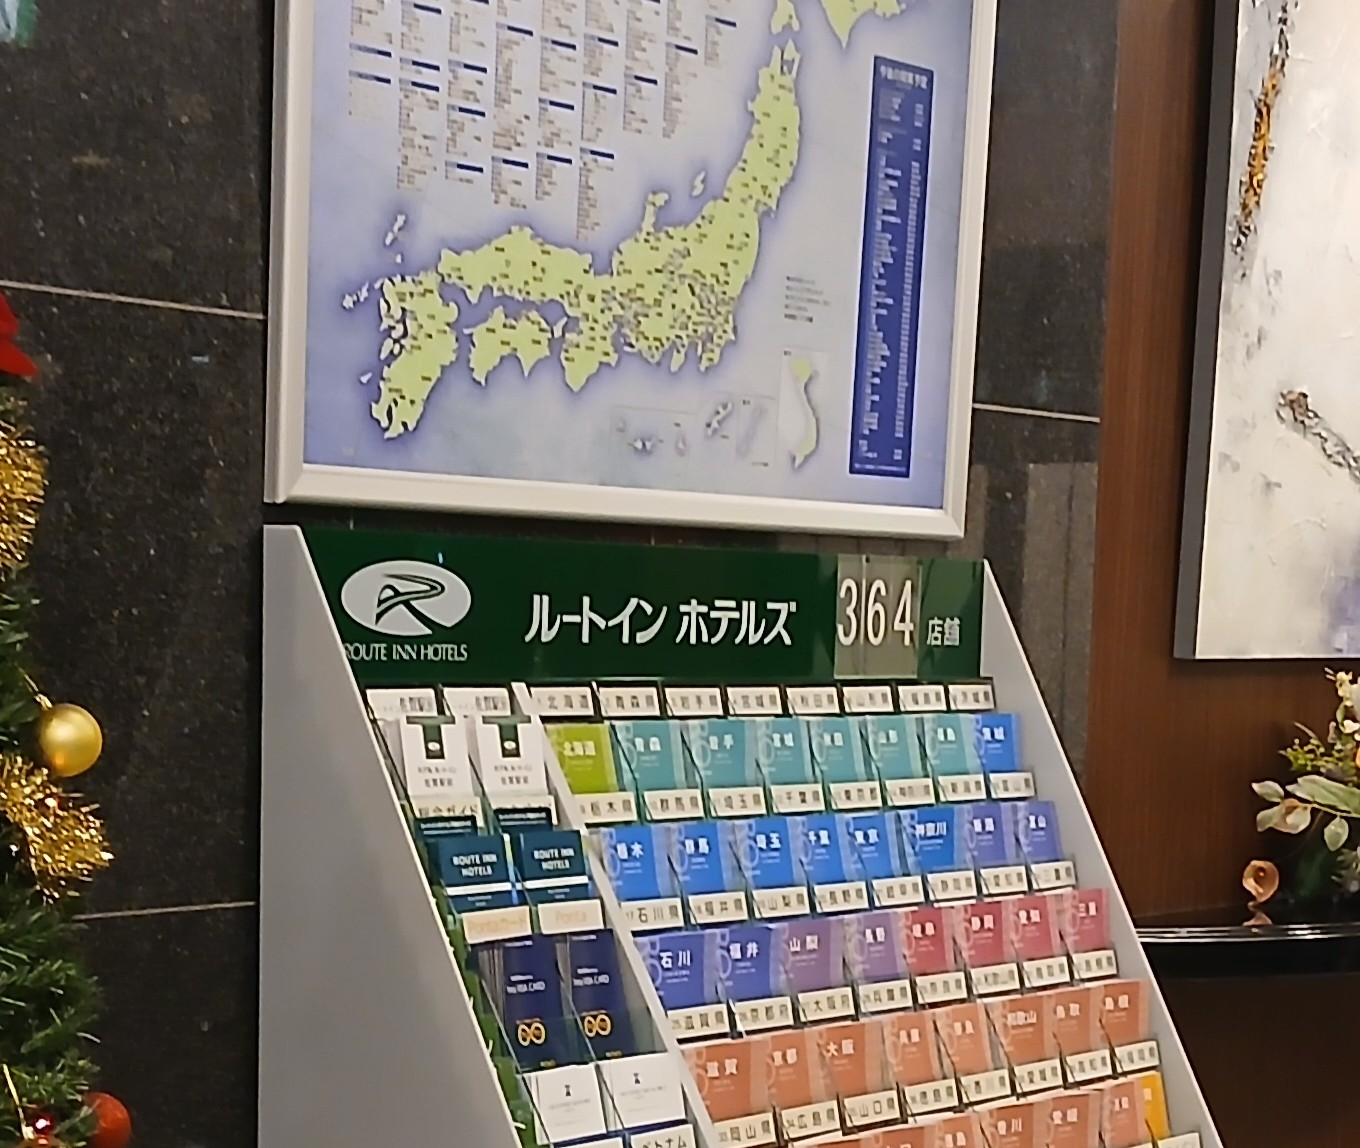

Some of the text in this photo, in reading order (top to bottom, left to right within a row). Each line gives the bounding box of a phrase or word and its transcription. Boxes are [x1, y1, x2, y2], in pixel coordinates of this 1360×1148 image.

[525, 594, 796, 646] ルートイン ホテルズ
[837, 577, 914, 647] 364
[393, 643, 418, 662] INN
[420, 643, 468, 662] HOTELS
